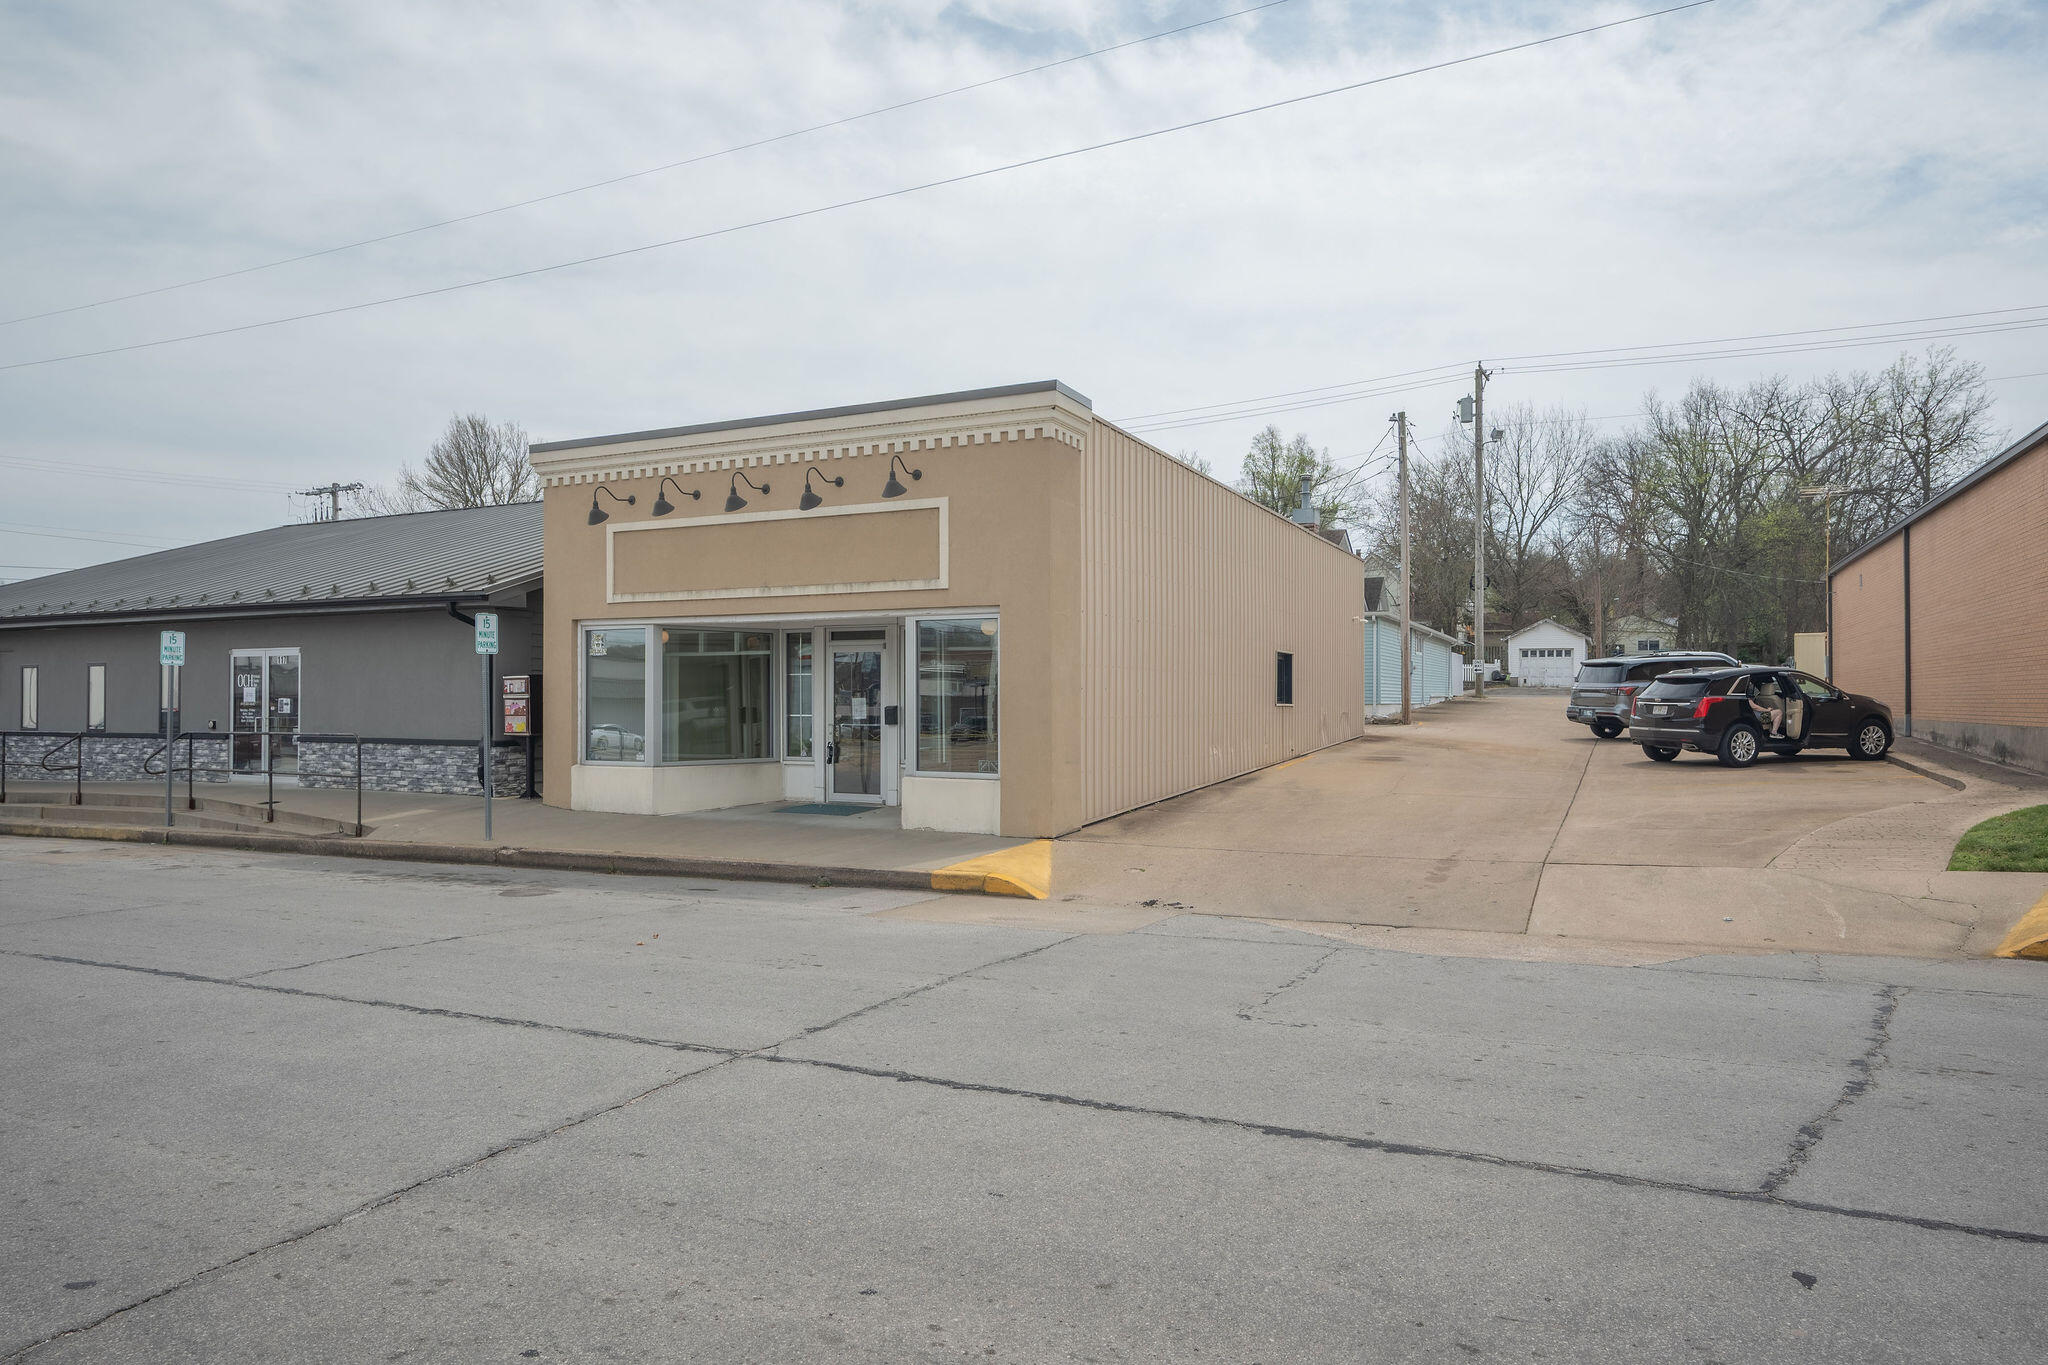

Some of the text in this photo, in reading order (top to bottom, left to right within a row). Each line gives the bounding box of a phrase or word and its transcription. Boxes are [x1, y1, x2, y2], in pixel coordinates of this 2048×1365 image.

[483, 618, 491, 628] 15
[478, 630, 496, 639] MINUTE
[169, 635, 177, 644] 15
[477, 640, 497, 649] PARKING
[237, 673, 253, 688] OCH
